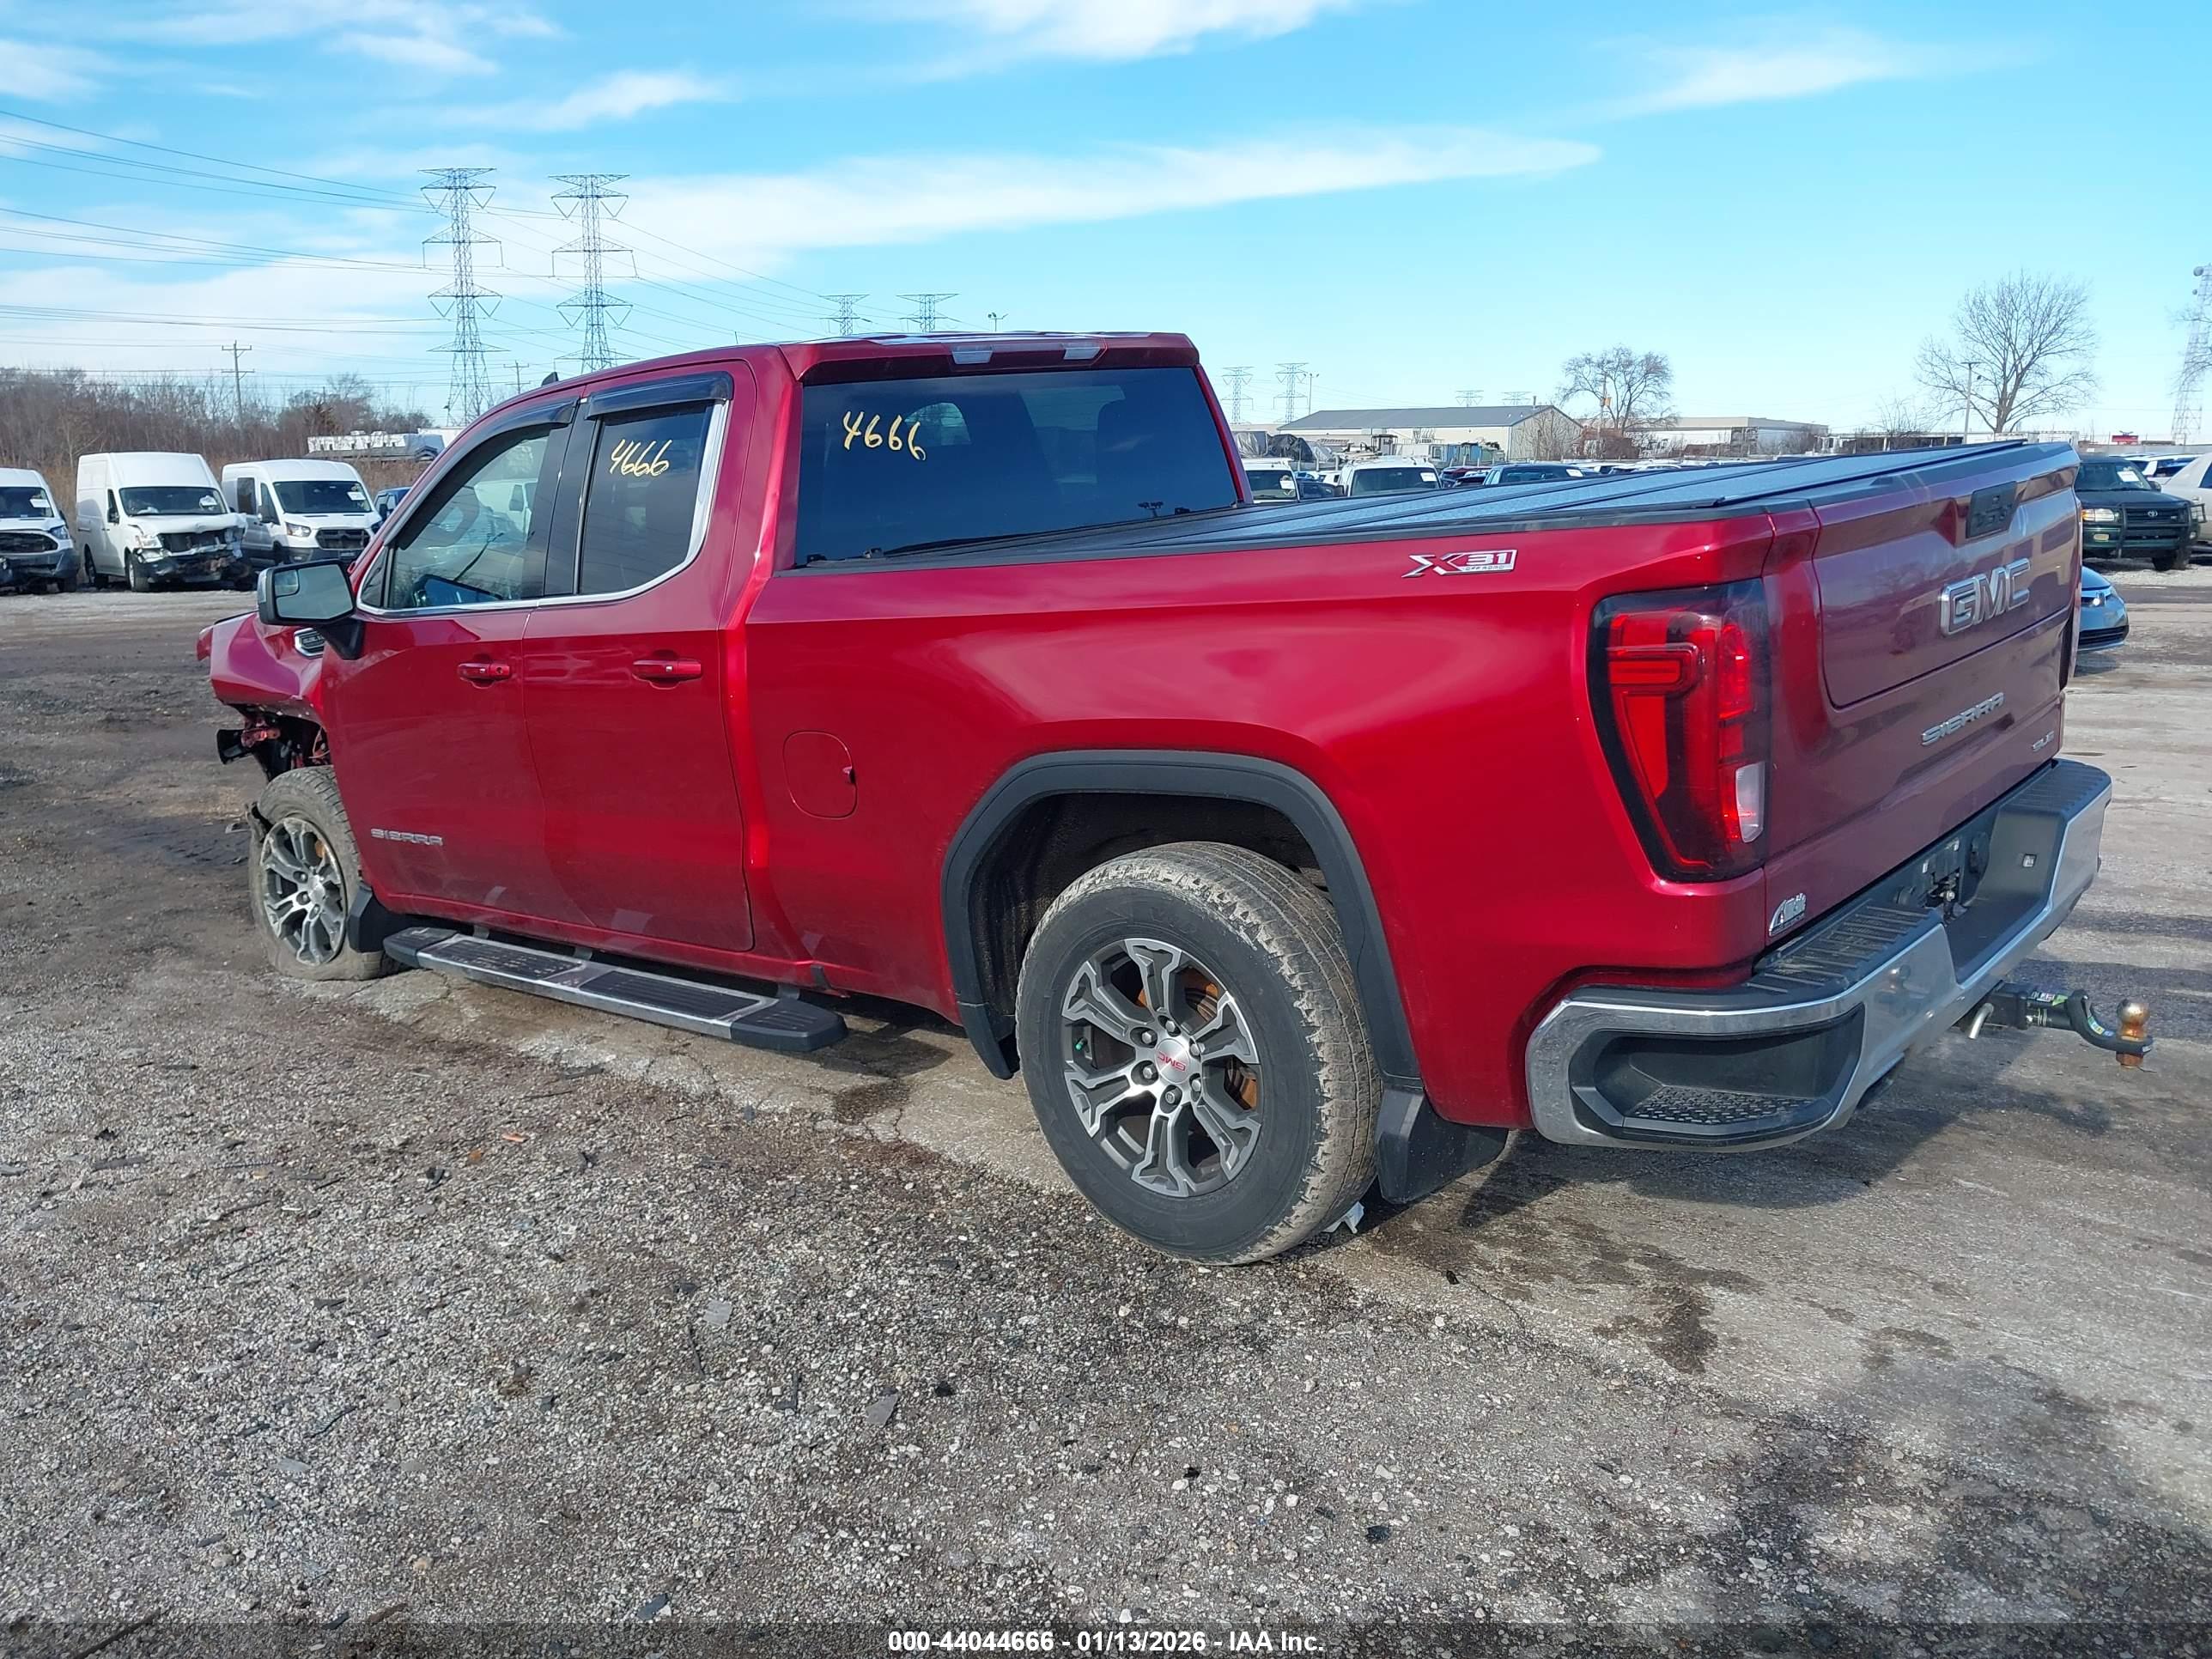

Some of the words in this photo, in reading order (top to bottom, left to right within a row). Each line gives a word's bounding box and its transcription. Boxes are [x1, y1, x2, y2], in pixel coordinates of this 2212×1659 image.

[842, 410, 927, 461] 4666
[609, 439, 672, 477] 4666
[1939, 557, 2030, 635] GMC
[1921, 691, 2004, 746] SIERRA
[370, 828, 443, 846] SIERRA
[1157, 1050, 1186, 1072] GMC
